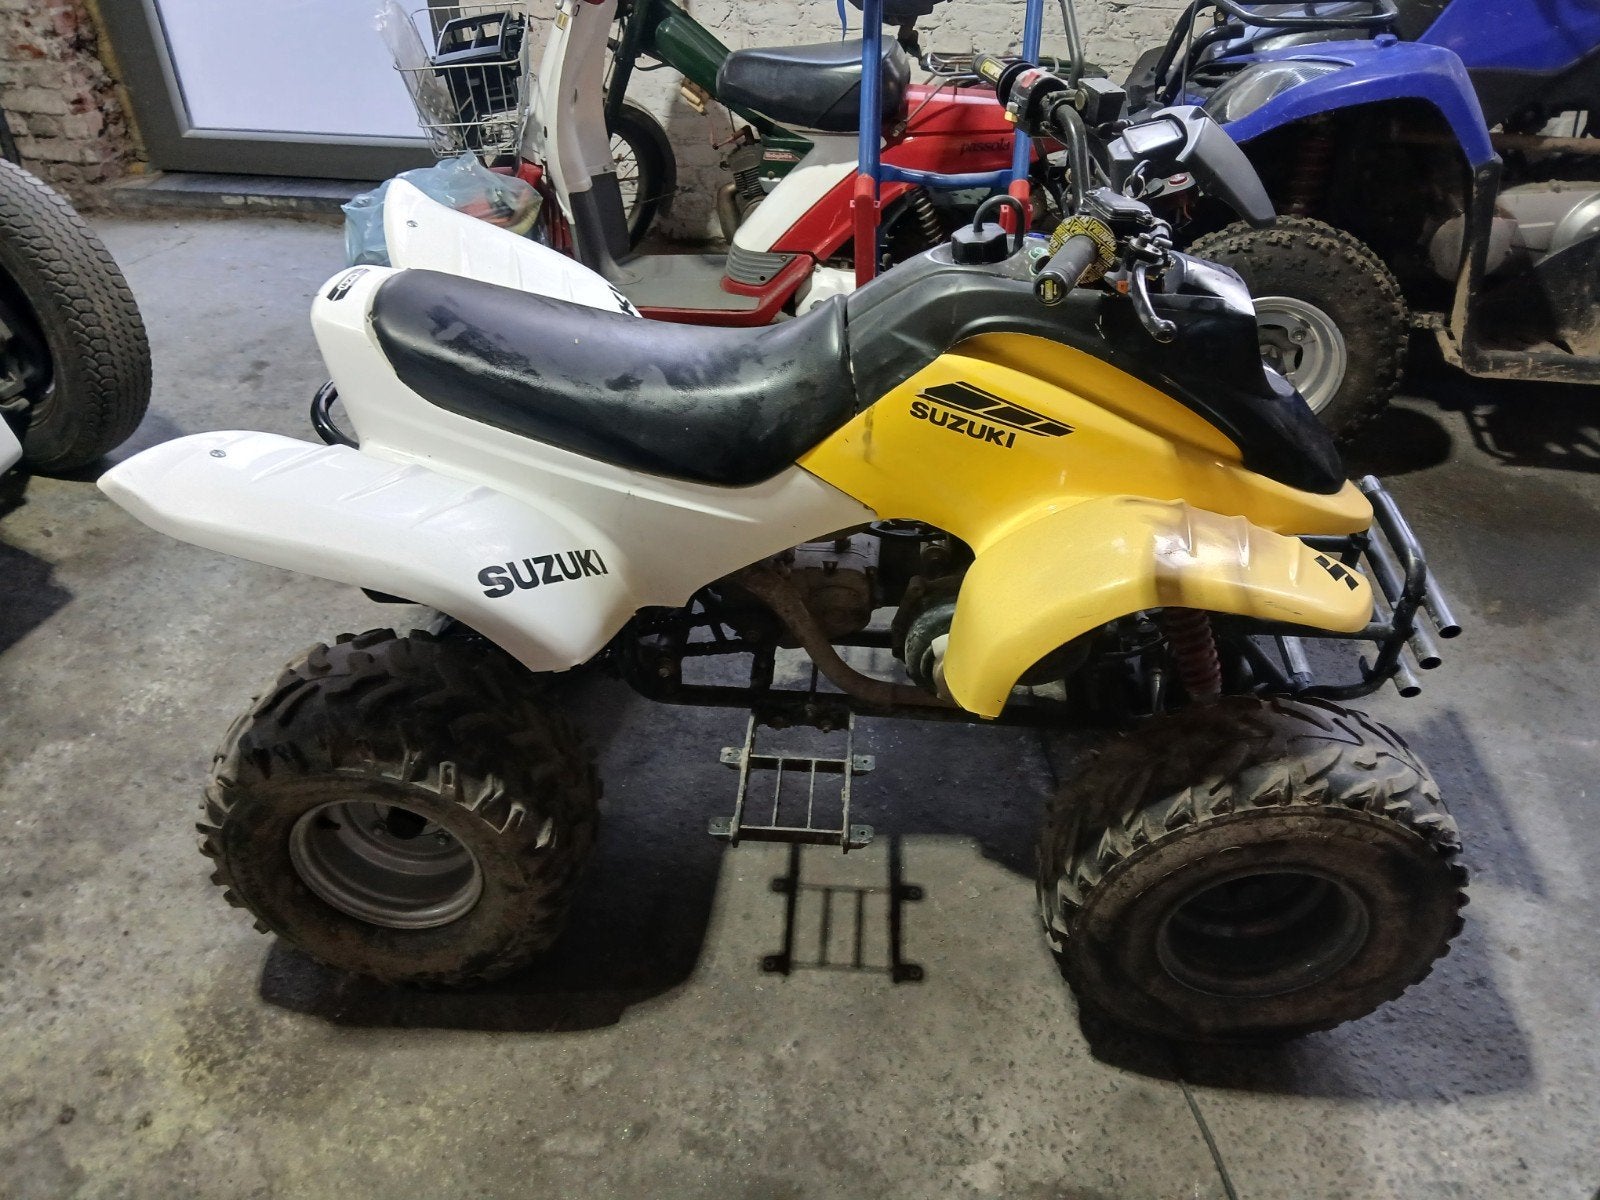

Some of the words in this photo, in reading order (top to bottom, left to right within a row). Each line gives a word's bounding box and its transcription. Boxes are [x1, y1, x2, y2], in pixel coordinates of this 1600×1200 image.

[960, 138, 1010, 156] passola
[909, 401, 1017, 449] SUZUKI
[477, 549, 609, 599] SUZUKI
